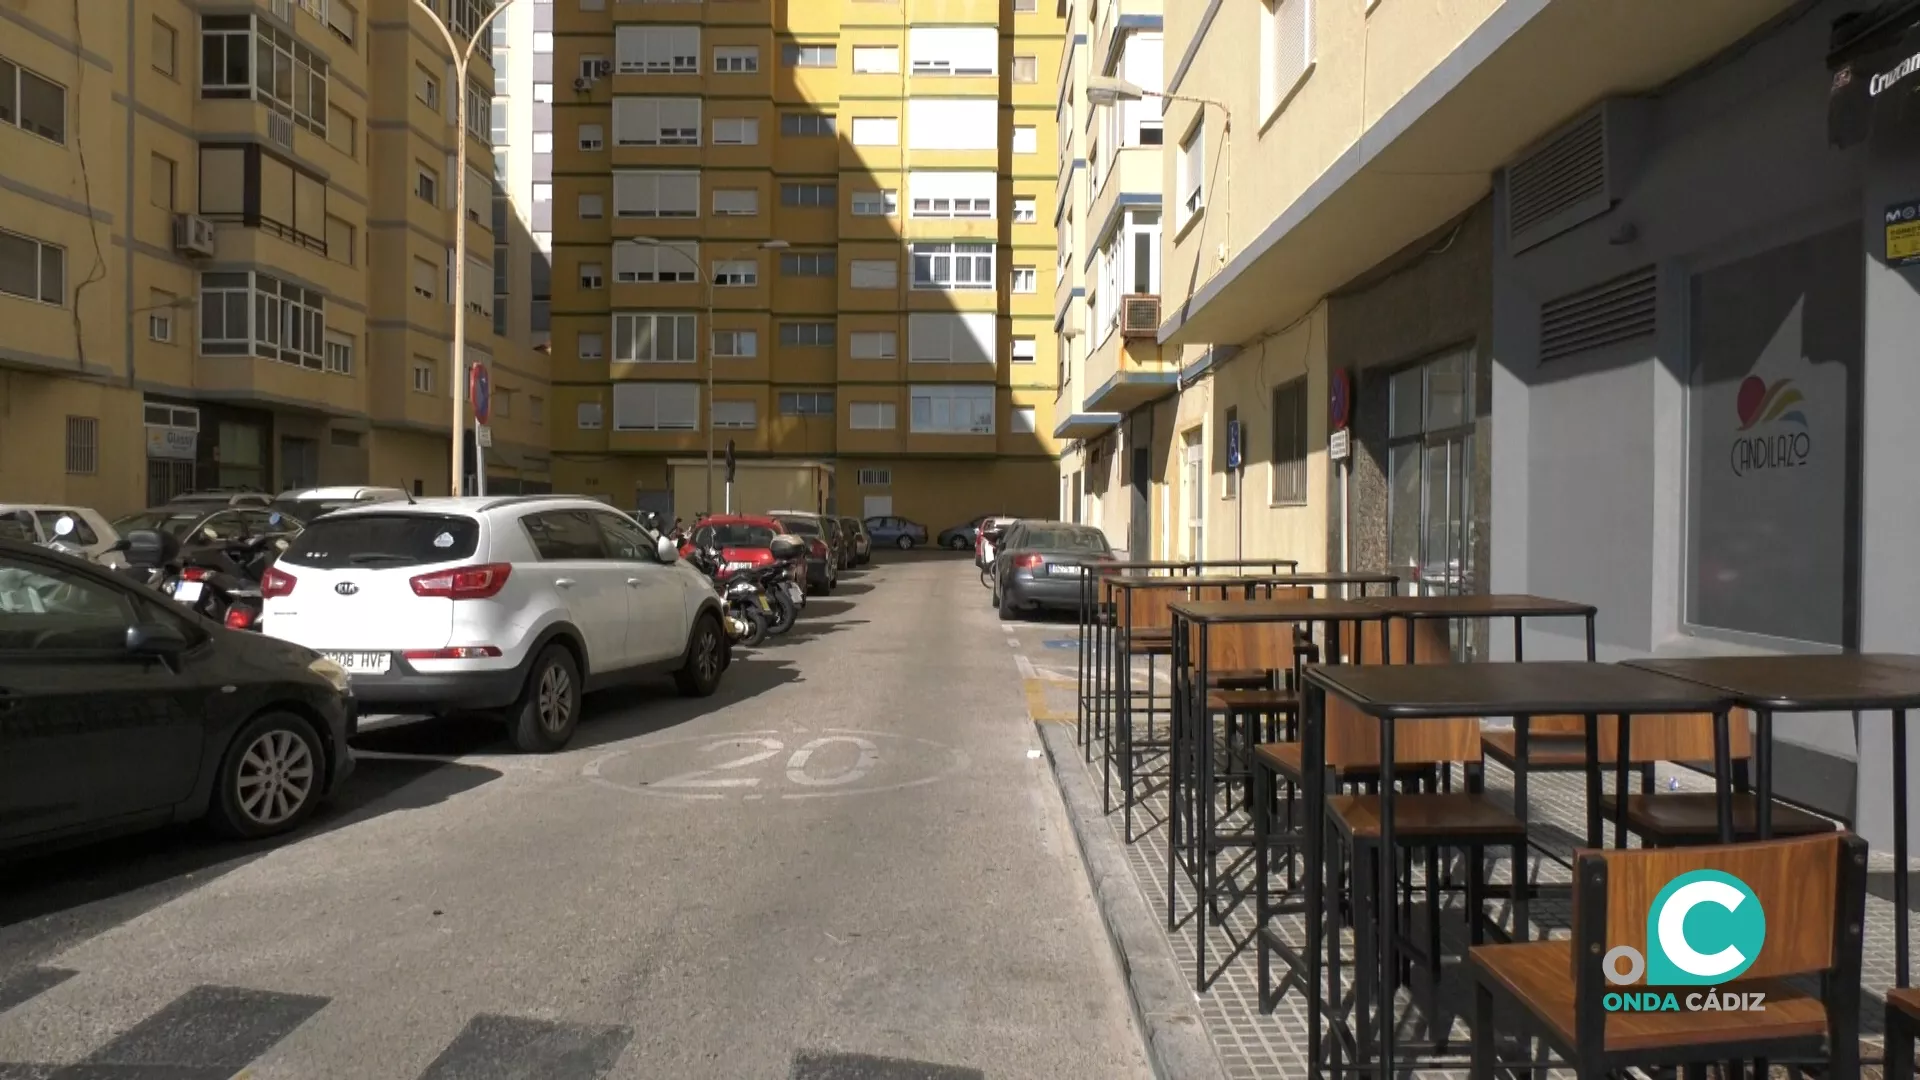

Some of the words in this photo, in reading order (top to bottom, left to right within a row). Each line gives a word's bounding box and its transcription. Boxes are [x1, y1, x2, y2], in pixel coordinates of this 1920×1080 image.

[1730, 431, 1810, 477] CANDILAZO
[336, 582, 357, 594] KIA
[361, 652, 386, 668] HVF
[645, 735, 879, 787] 20
